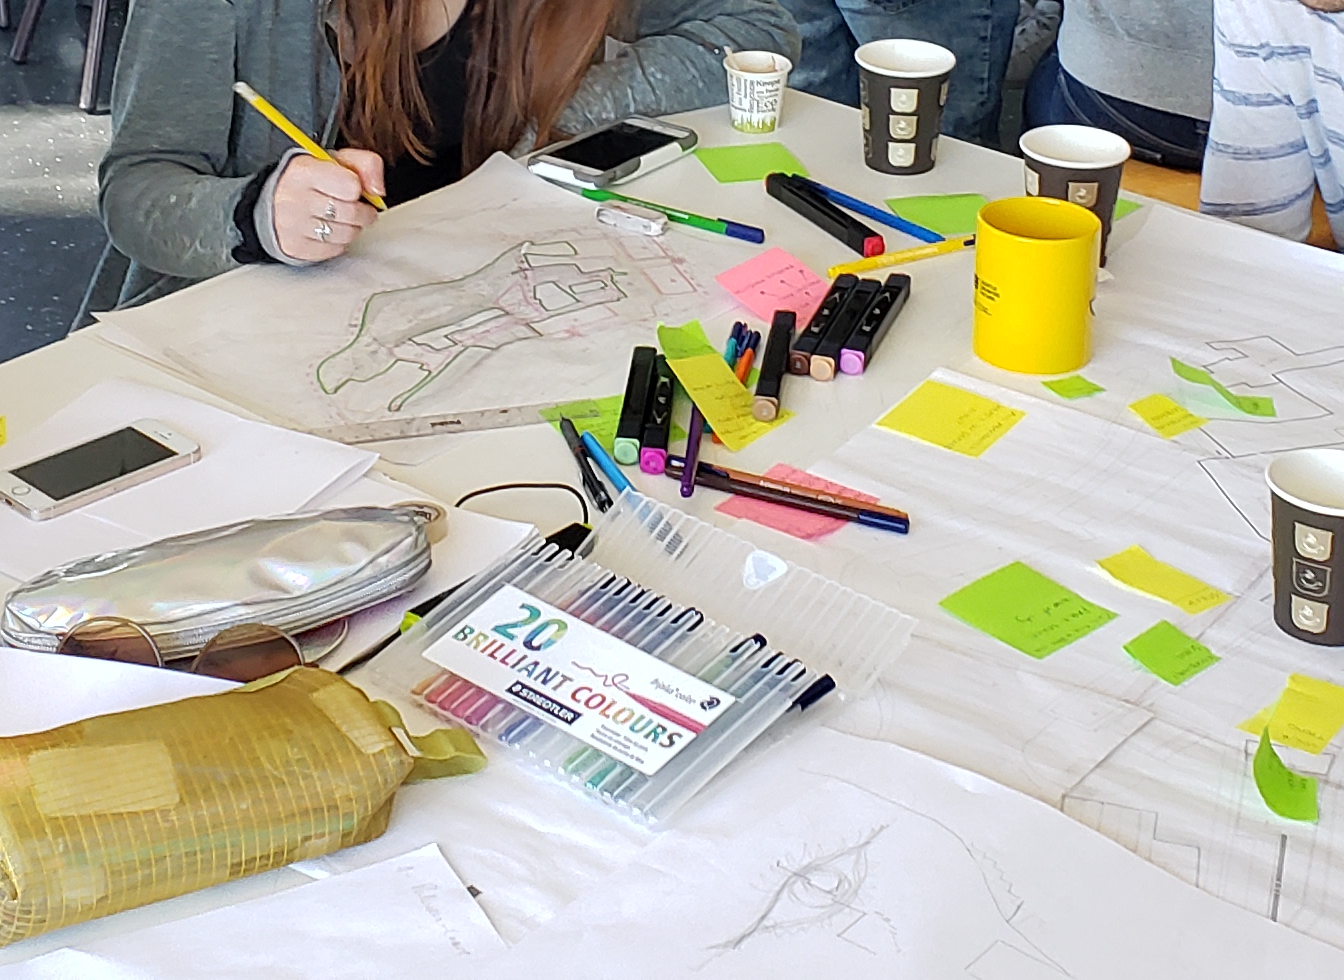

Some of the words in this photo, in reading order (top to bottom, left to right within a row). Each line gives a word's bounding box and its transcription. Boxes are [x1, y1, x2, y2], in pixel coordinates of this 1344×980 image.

[491, 603, 568, 651] 20
[452, 624, 574, 691] BRILLIANT
[570, 685, 684, 748] COLOURS
